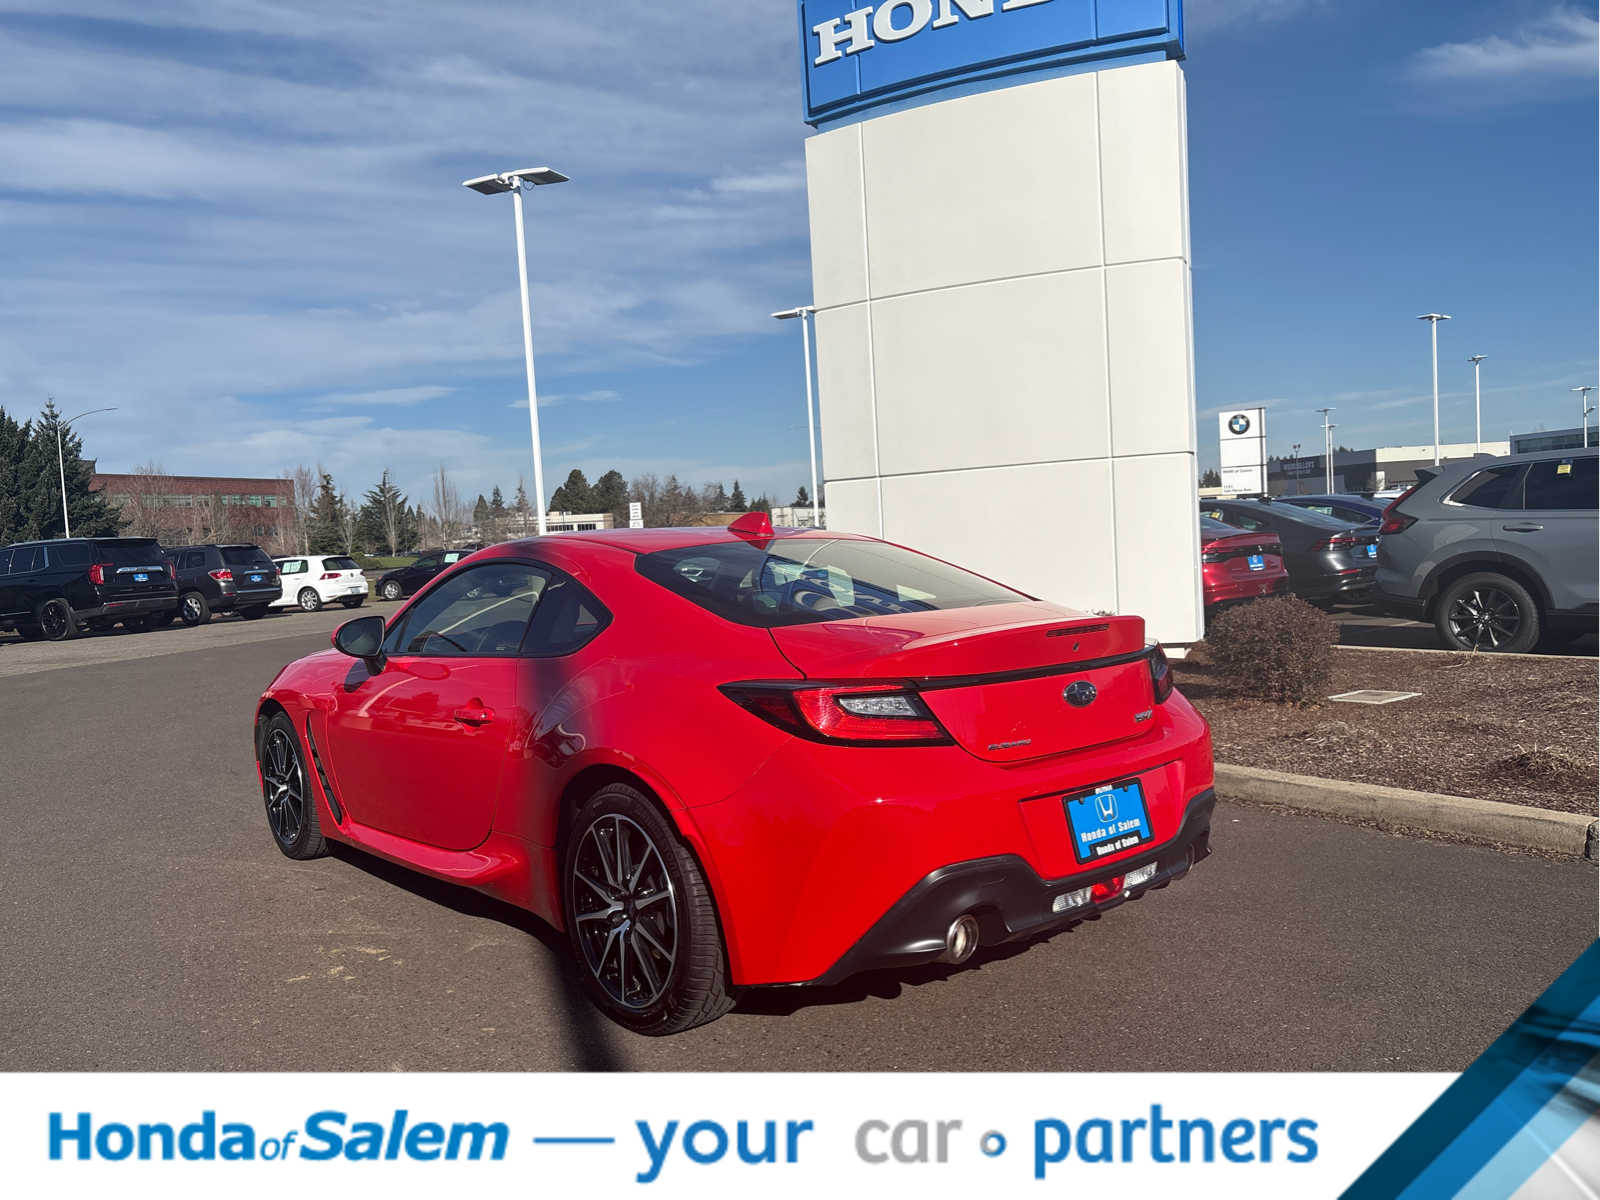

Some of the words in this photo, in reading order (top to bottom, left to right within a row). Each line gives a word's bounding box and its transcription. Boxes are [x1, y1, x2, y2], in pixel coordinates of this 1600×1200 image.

[812, 0, 1054, 66] HON
[1081, 829, 1106, 843] Honda
[1118, 818, 1140, 831] Salem
